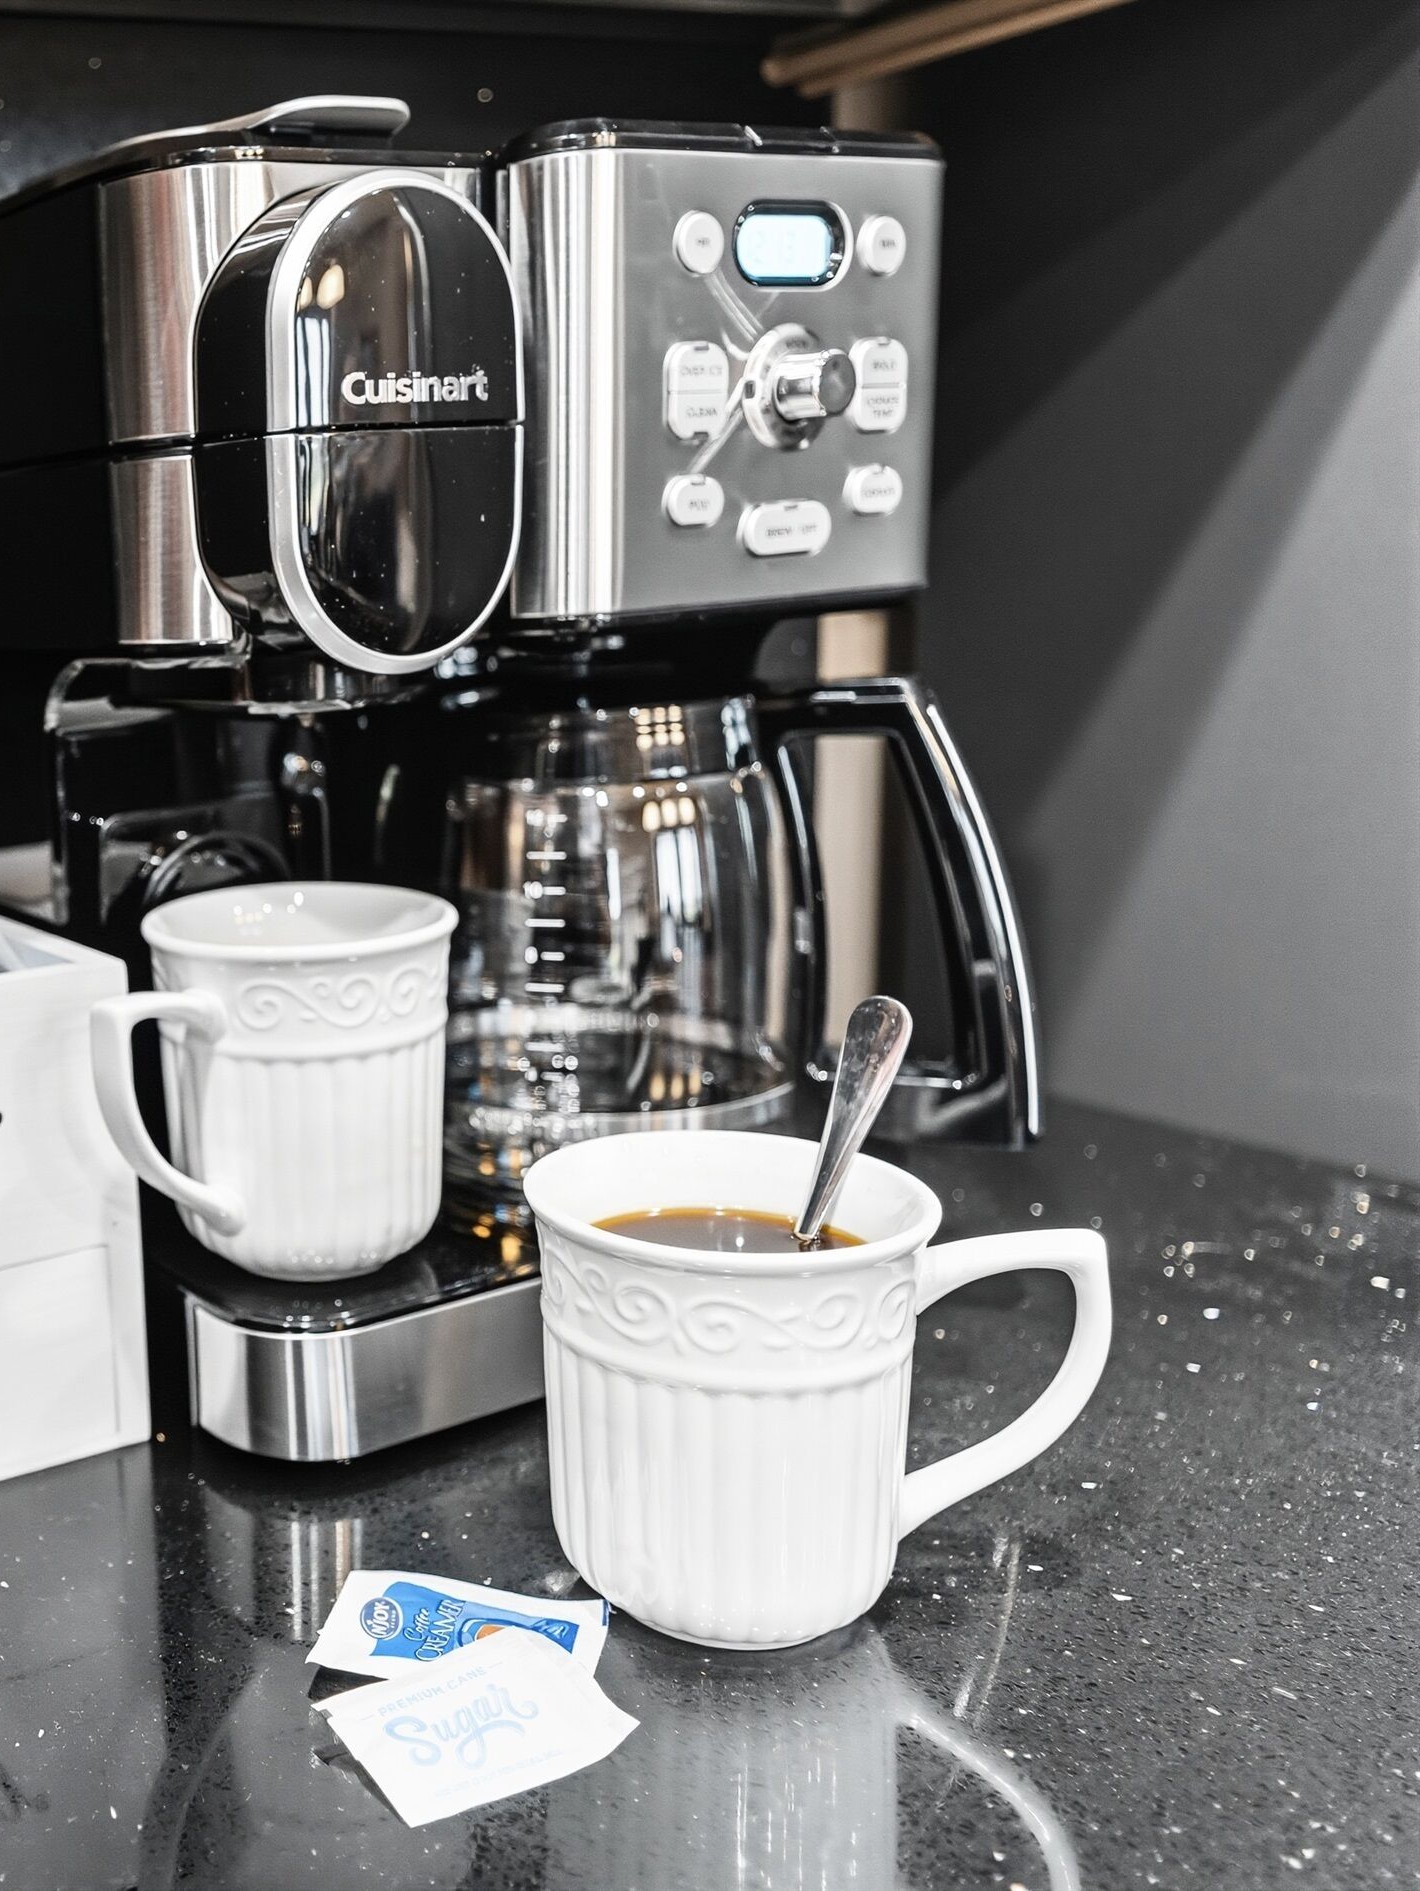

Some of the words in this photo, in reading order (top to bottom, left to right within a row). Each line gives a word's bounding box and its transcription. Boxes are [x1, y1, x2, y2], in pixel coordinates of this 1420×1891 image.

[341, 369, 489, 405] Cuisinart
[403, 1607, 431, 1642] Coffee
[415, 1599, 465, 1662] CREAMER
[378, 1685, 445, 1717] PREMIUM
[447, 1665, 486, 1690] CANE
[382, 1682, 539, 1770] Sugar
